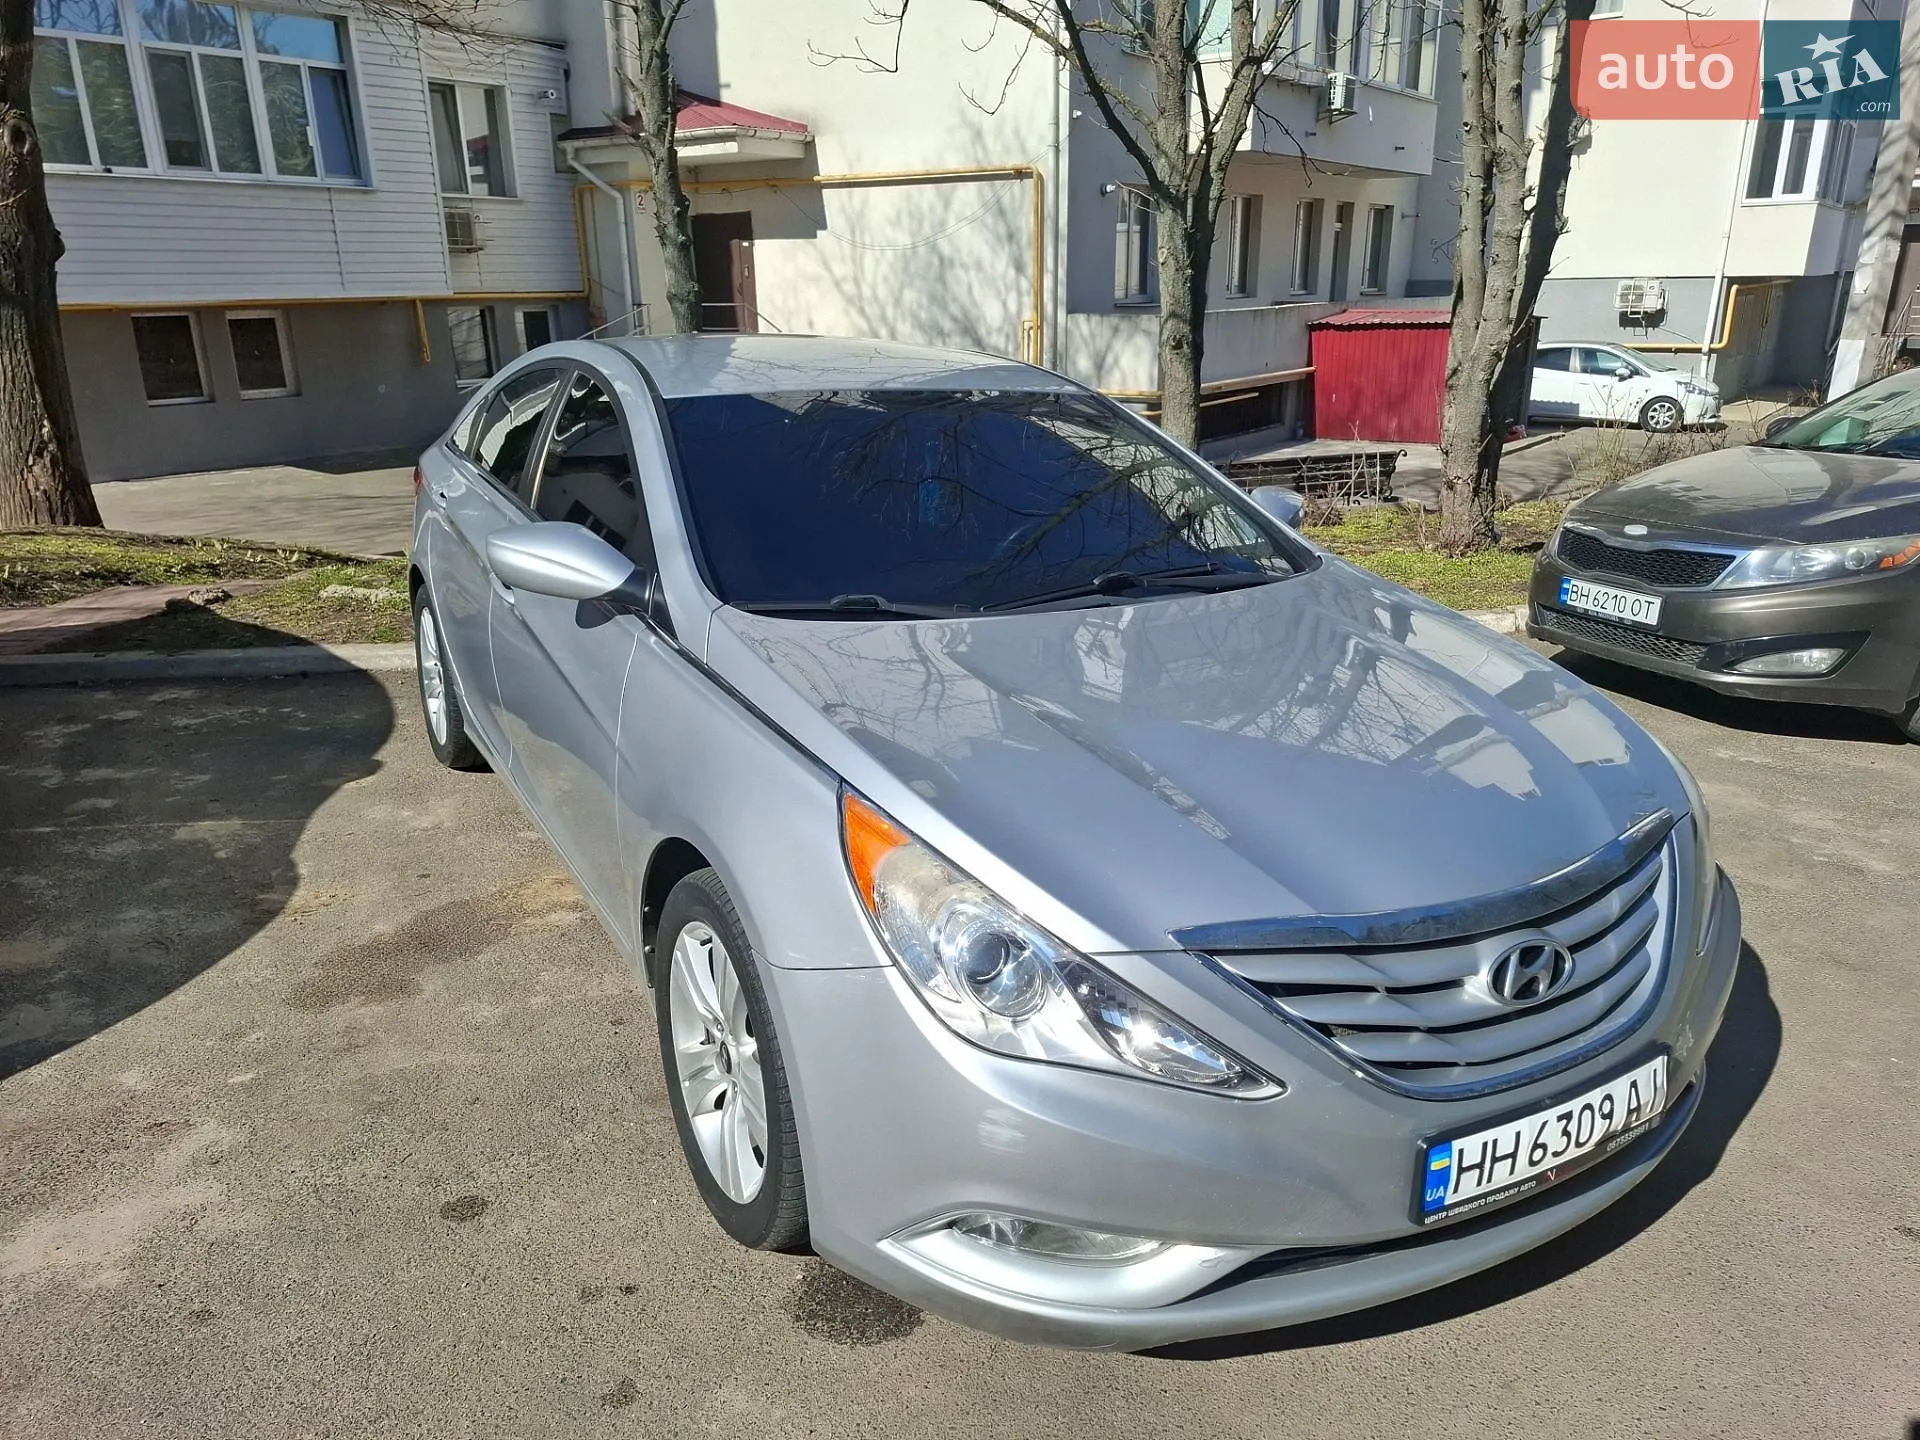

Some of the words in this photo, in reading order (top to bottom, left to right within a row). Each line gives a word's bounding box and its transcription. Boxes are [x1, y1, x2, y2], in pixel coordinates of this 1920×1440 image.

[637, 194, 644, 206] 2
[1569, 584, 1591, 605] BH
[1592, 590, 1628, 613] 6210
[1630, 598, 1656, 620] OT
[1452, 1130, 1522, 1195] HH
[1527, 1092, 1615, 1168] 6309
[1620, 1068, 1658, 1131] AI
[1424, 1210, 1448, 1225] ЦЕНТР
[1447, 1198, 1486, 1217] ШВИДКОГО
[1486, 1186, 1520, 1204] ПРОДАЖУ
[1519, 1180, 1537, 1192] АВТО
[1426, 1185, 1445, 1202] UA
